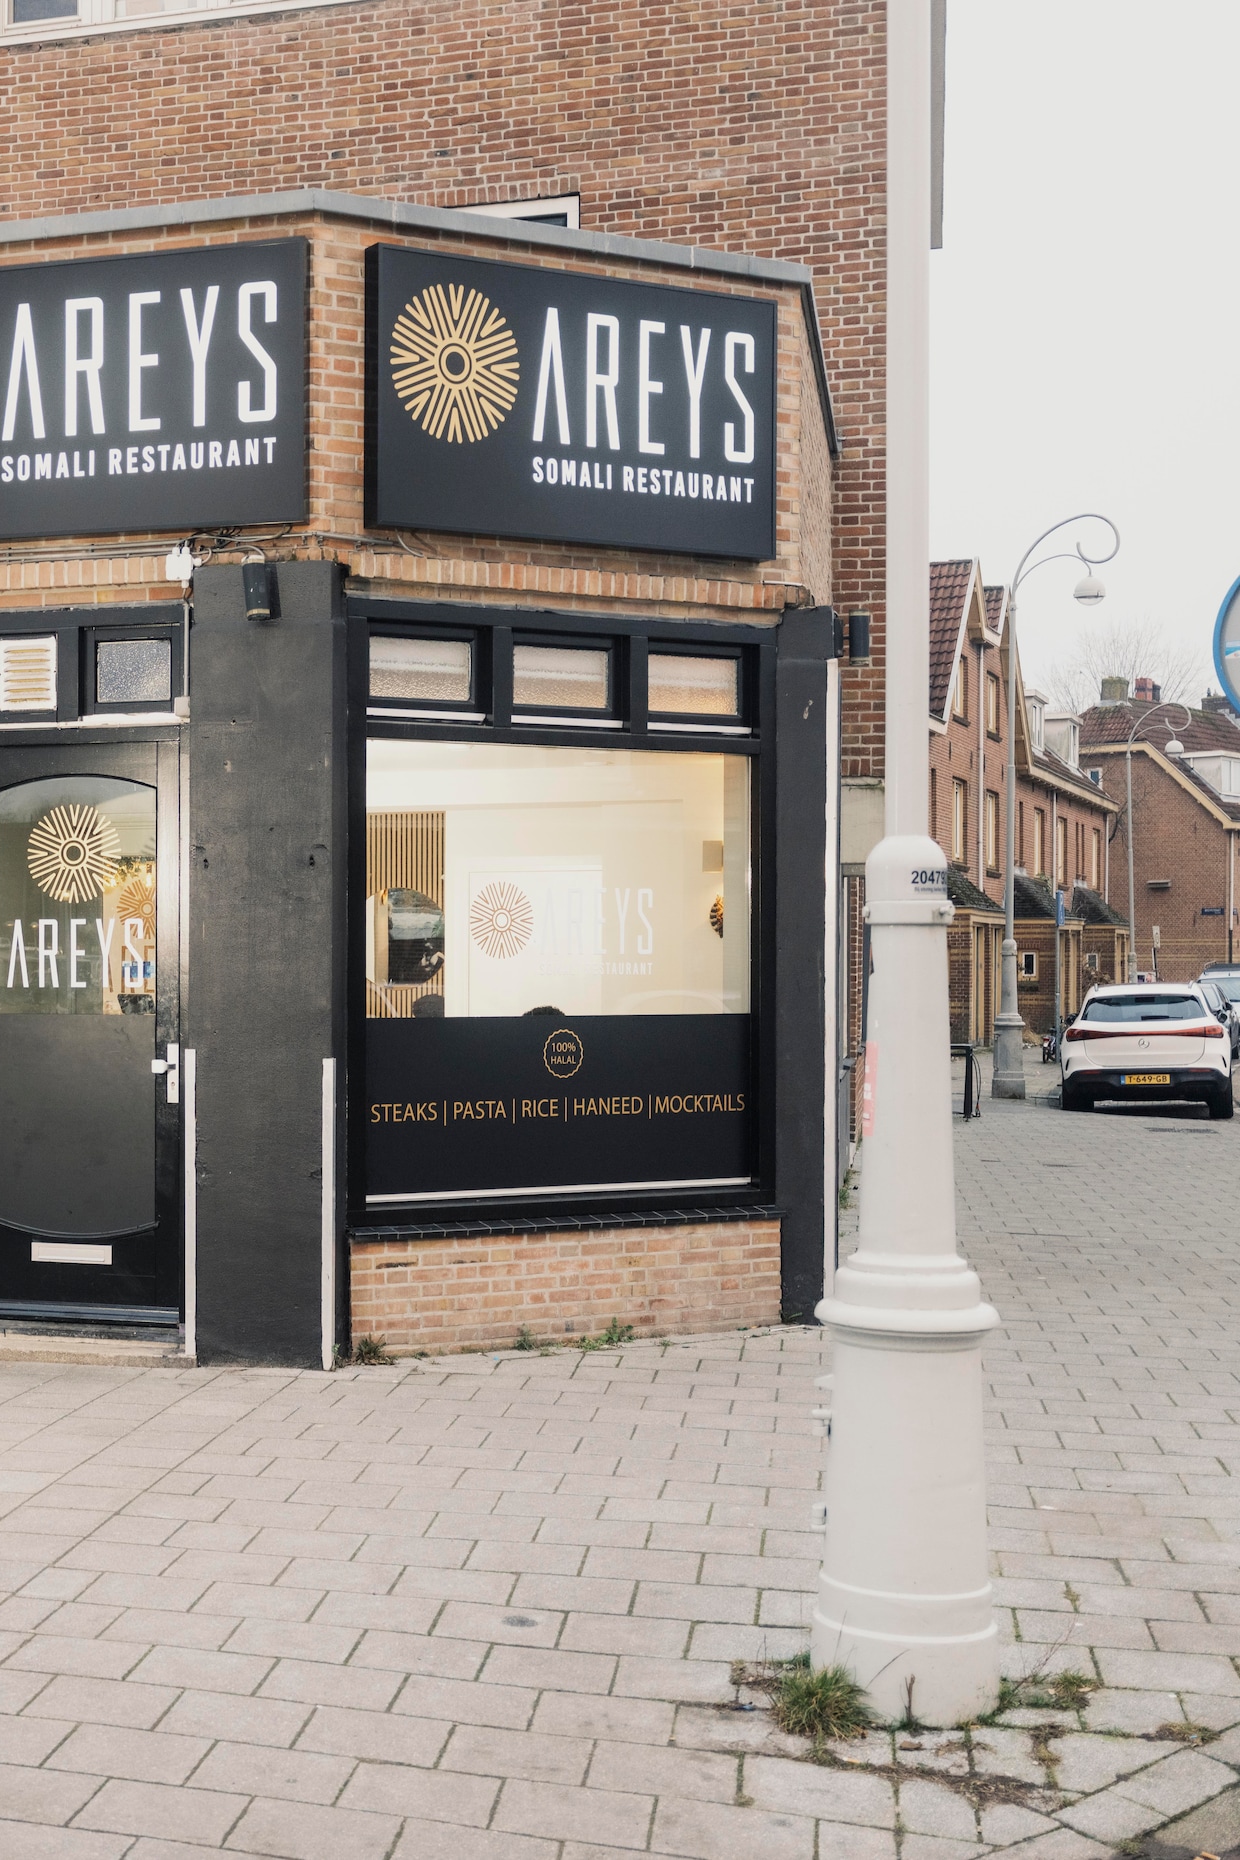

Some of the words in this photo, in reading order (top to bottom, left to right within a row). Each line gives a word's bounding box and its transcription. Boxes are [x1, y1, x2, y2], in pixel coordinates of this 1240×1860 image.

[2, 280, 277, 441] AREYS
[533, 307, 755, 463] AREYS
[1, 450, 96, 482] SOMALI
[109, 437, 277, 474] RESTAURANT
[532, 457, 612, 490] SOMALI
[623, 466, 754, 503] RESTAURANT
[539, 888, 653, 955] AREYS
[7, 918, 143, 988] AREYS
[551, 1056, 576, 1064] HALAL
[552, 1042, 576, 1052] 100%
[370, 1102, 438, 1122] STEAKS
[453, 1100, 507, 1119] PASTA
[521, 1098, 559, 1118] RICE
[573, 1096, 644, 1116] HANEED
[655, 1094, 745, 1114] MOCKTAILS
